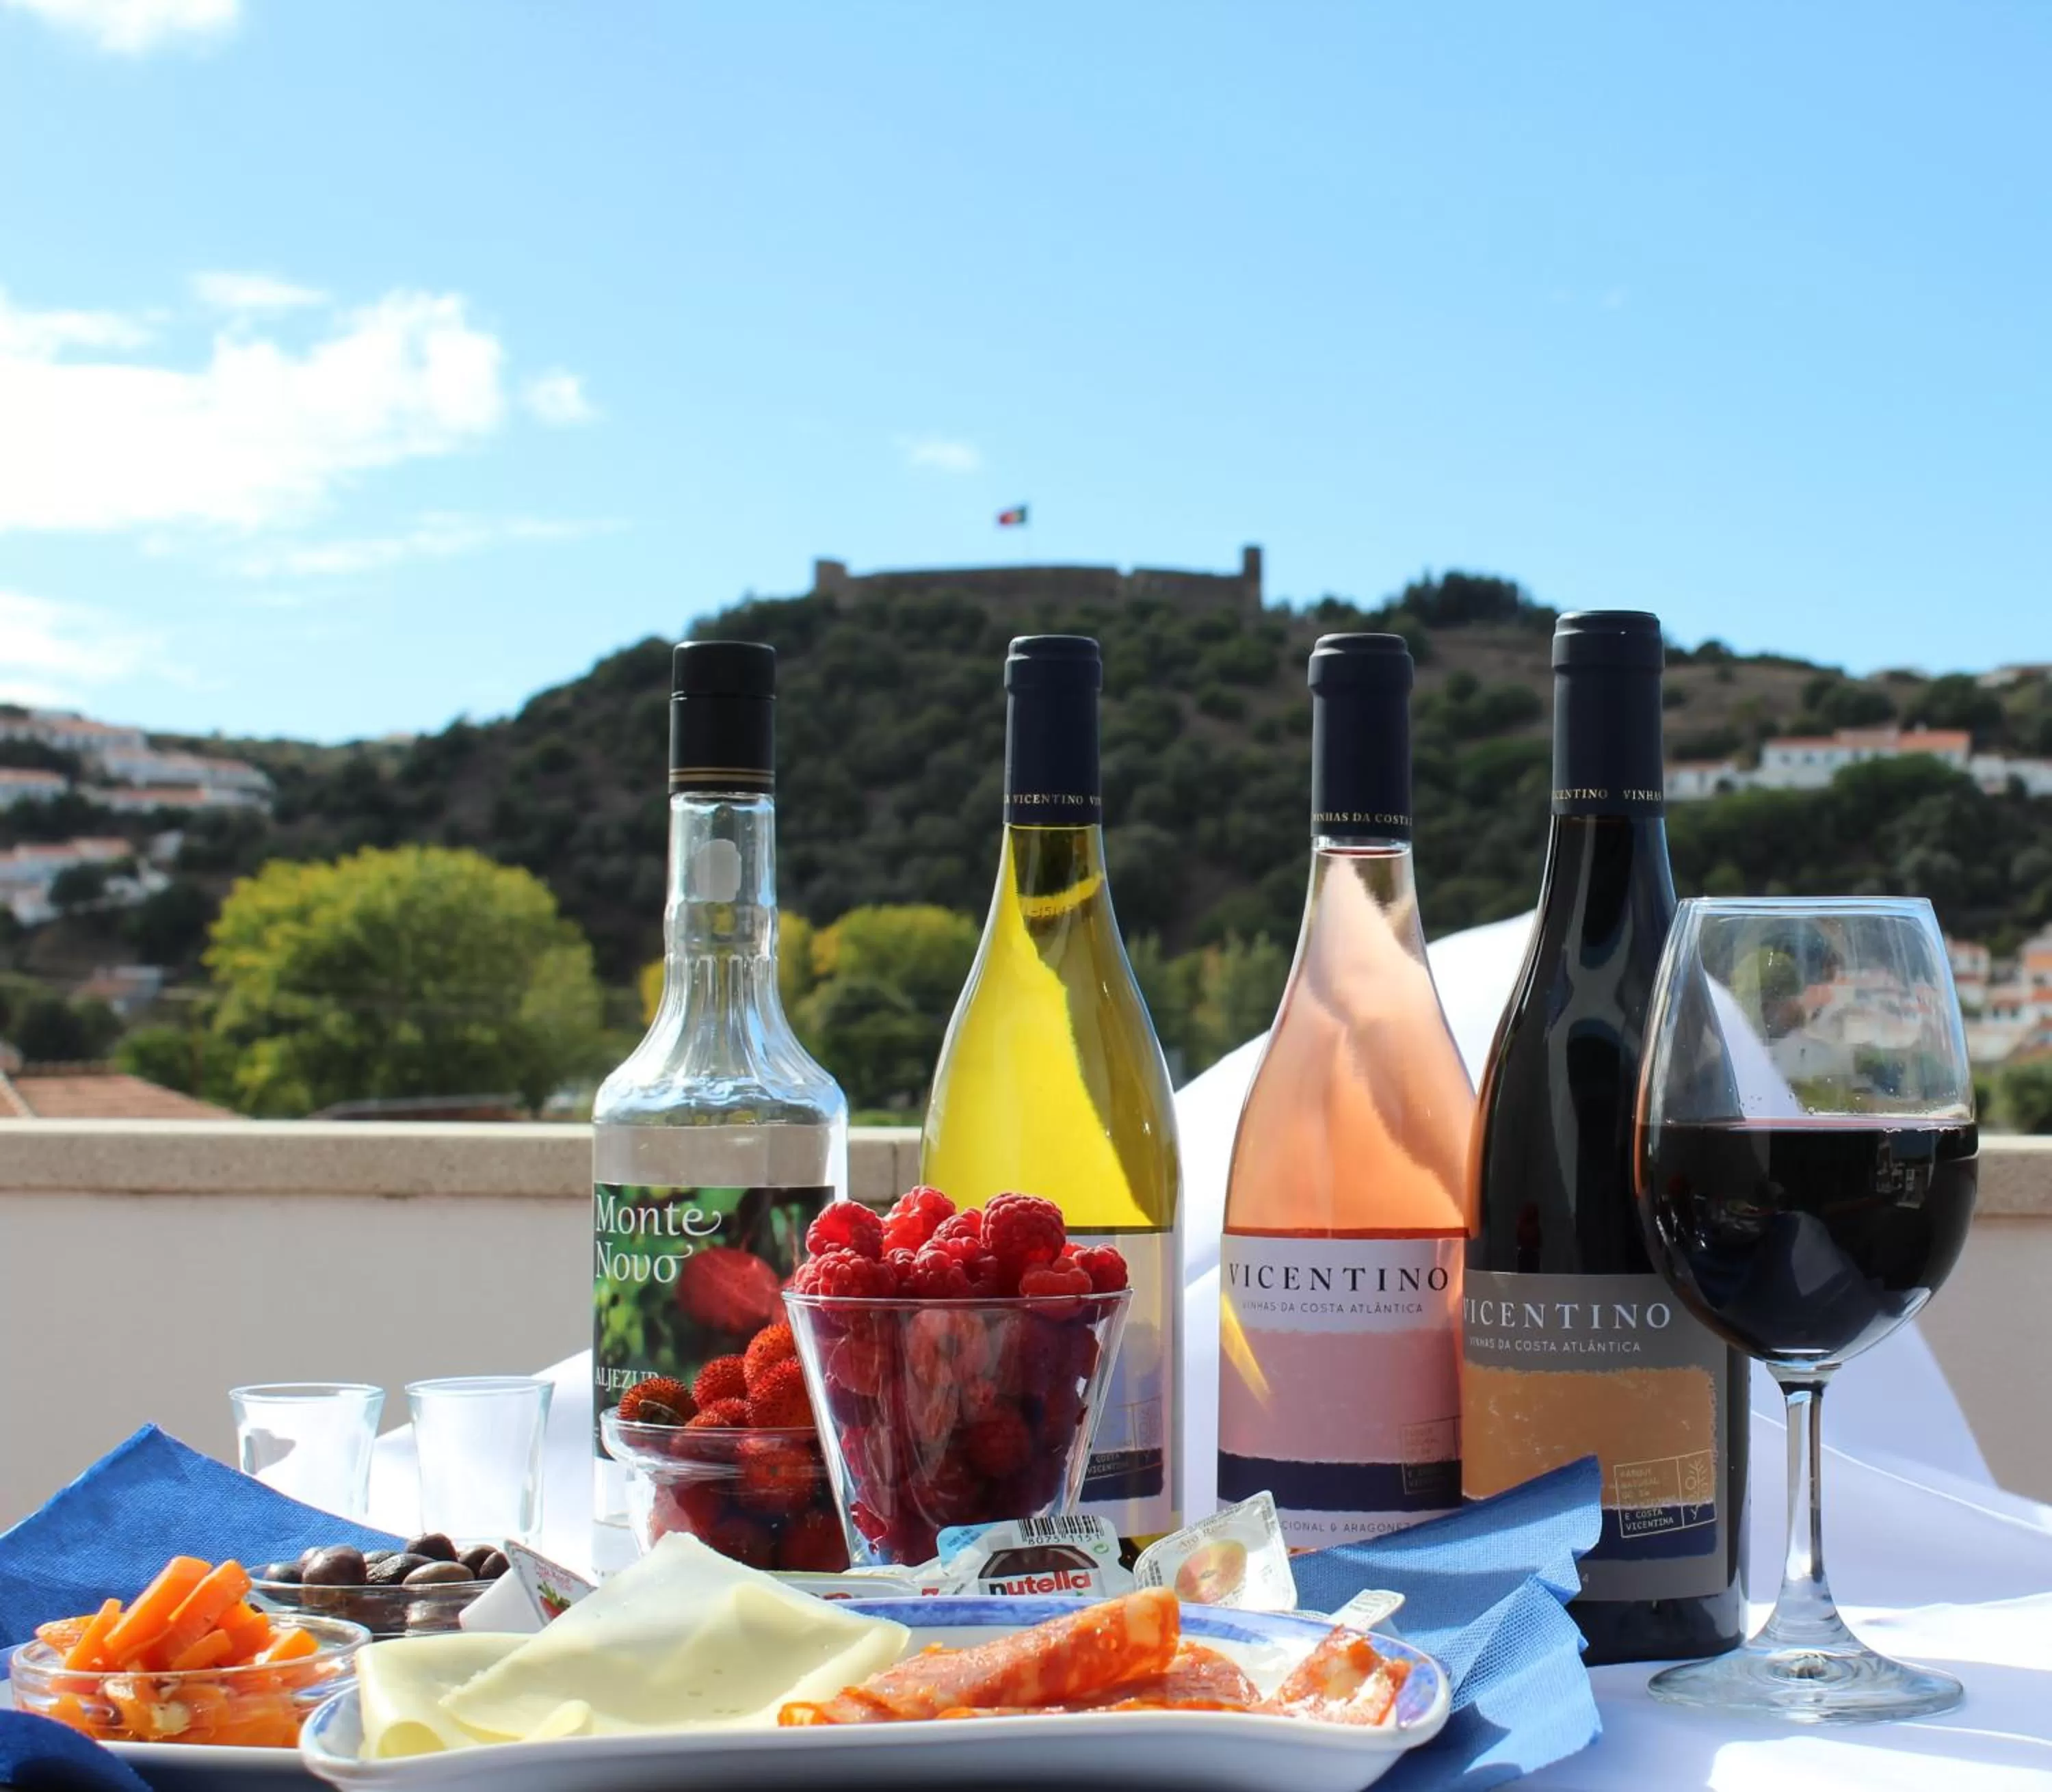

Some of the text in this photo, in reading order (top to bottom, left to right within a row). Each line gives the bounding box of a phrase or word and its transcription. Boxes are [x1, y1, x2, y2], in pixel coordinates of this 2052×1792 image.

[1012, 793, 1083, 805] VICENTINO
[1352, 812, 1371, 822] DA
[595, 1194, 722, 1236] Monte
[595, 1240, 694, 1283] Novo
[1229, 1263, 1449, 1292] VICENTINO
[1280, 1302, 1295, 1312] DA
[1300, 1302, 1344, 1314] COSTA
[1350, 1301, 1423, 1314] ATLÂNTICA
[1498, 1338, 1511, 1350] DA
[1514, 1339, 1557, 1352] COSTA
[1562, 1339, 1641, 1353] ATLÂNTICA
[1625, 1507, 1663, 1520] E COSTA
[1626, 1516, 1674, 1531] VICENTINA
[989, 1568, 1092, 1596] nutella
